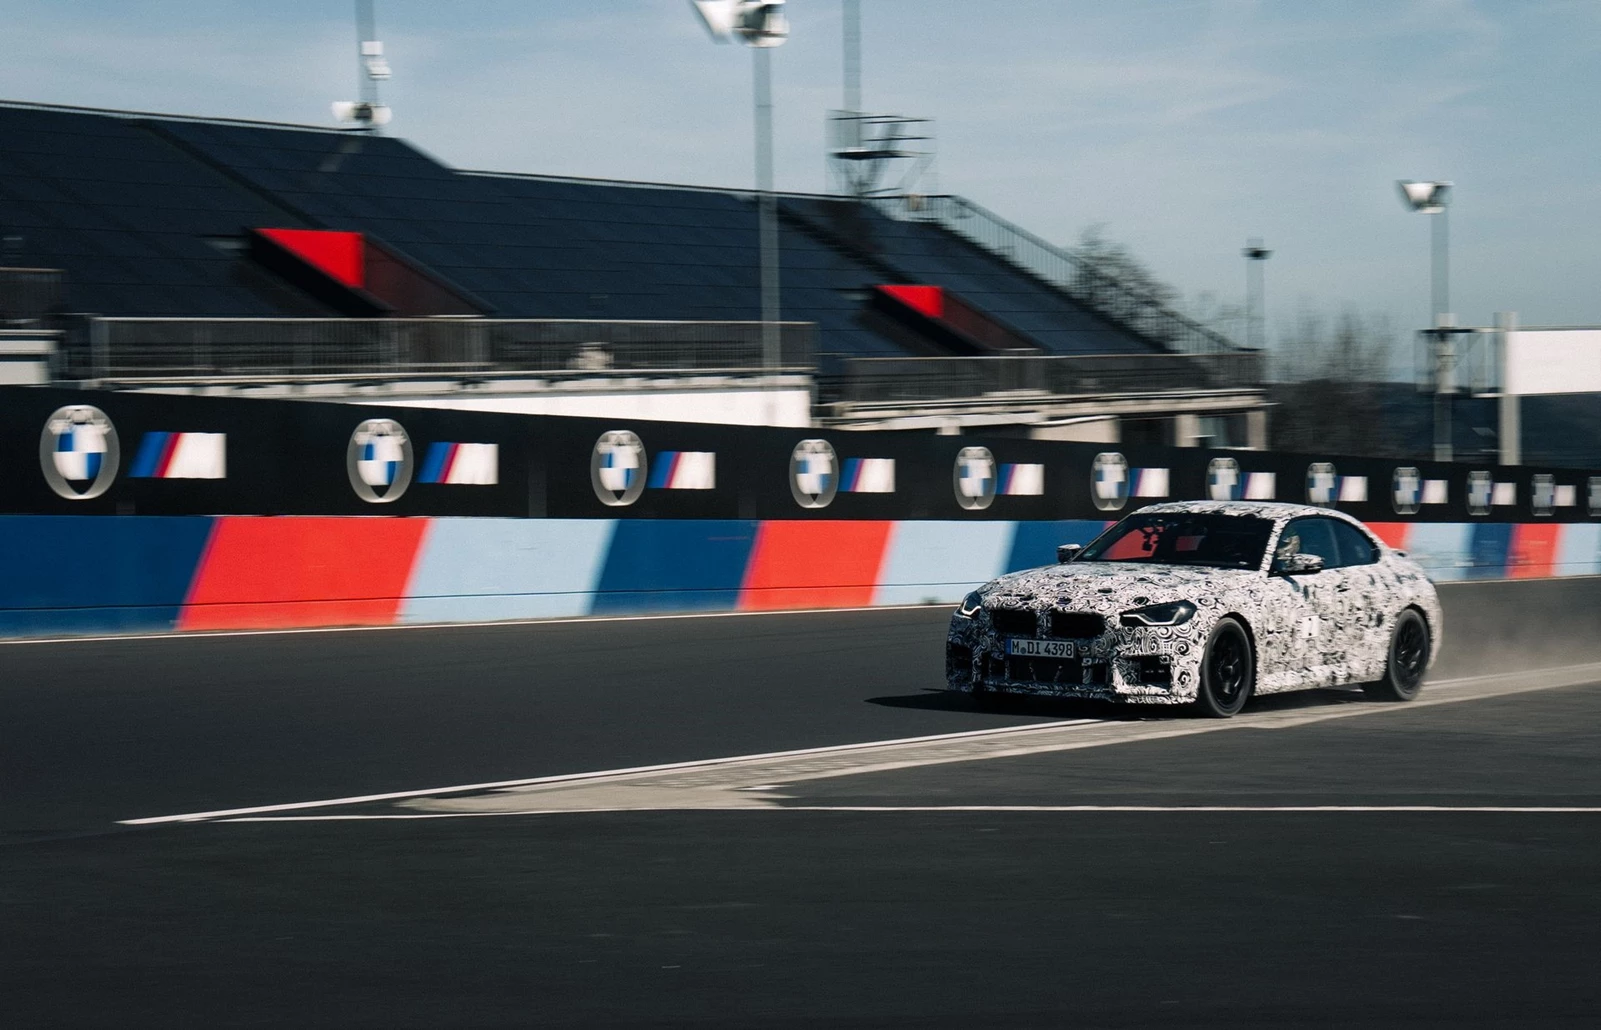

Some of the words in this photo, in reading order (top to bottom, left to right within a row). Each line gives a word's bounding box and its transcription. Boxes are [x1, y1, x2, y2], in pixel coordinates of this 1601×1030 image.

[1012, 641, 1019, 653] M
[1027, 642, 1040, 654] DI
[1044, 643, 1073, 656] 4398
